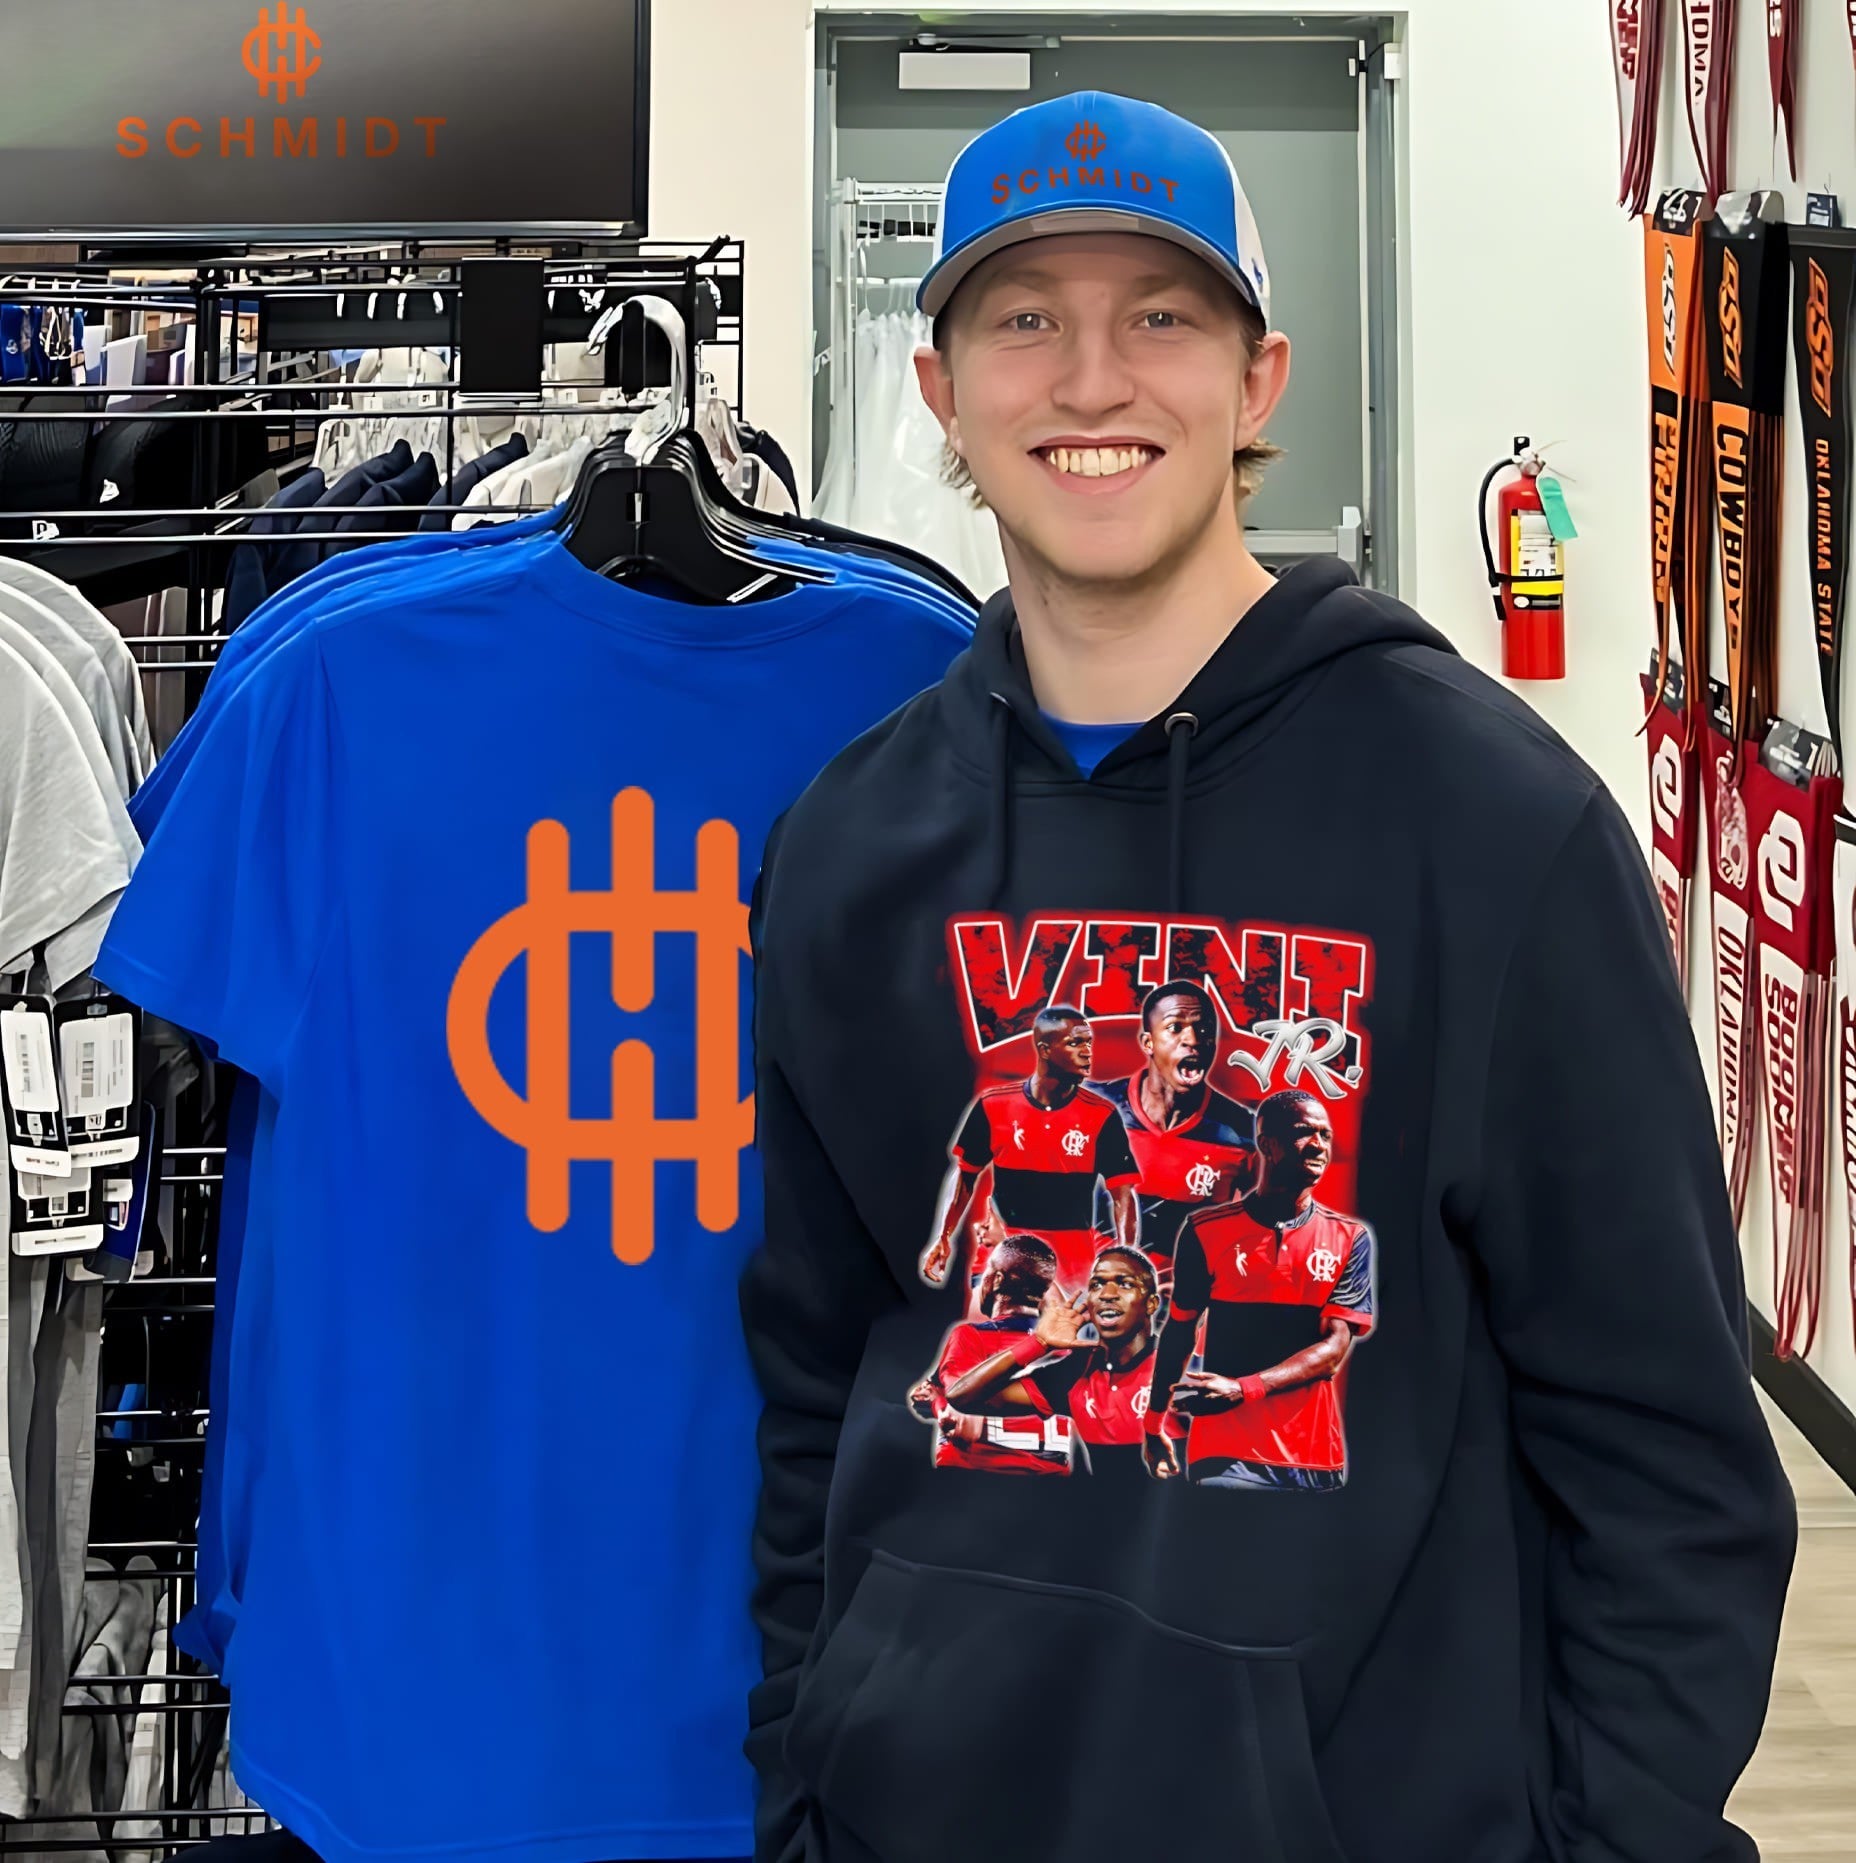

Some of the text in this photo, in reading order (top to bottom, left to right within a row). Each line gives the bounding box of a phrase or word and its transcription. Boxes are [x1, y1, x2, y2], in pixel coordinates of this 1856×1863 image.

[115, 116, 448, 159] SCHMIDT
[991, 166, 1180, 204] SCHMIDT
[1815, 438, 1832, 570] OKLAHOMA
[953, 919, 1367, 1087] VINI
[1717, 925, 1745, 1144] OKLAHOMA
[1227, 1018, 1363, 1100] JR.
